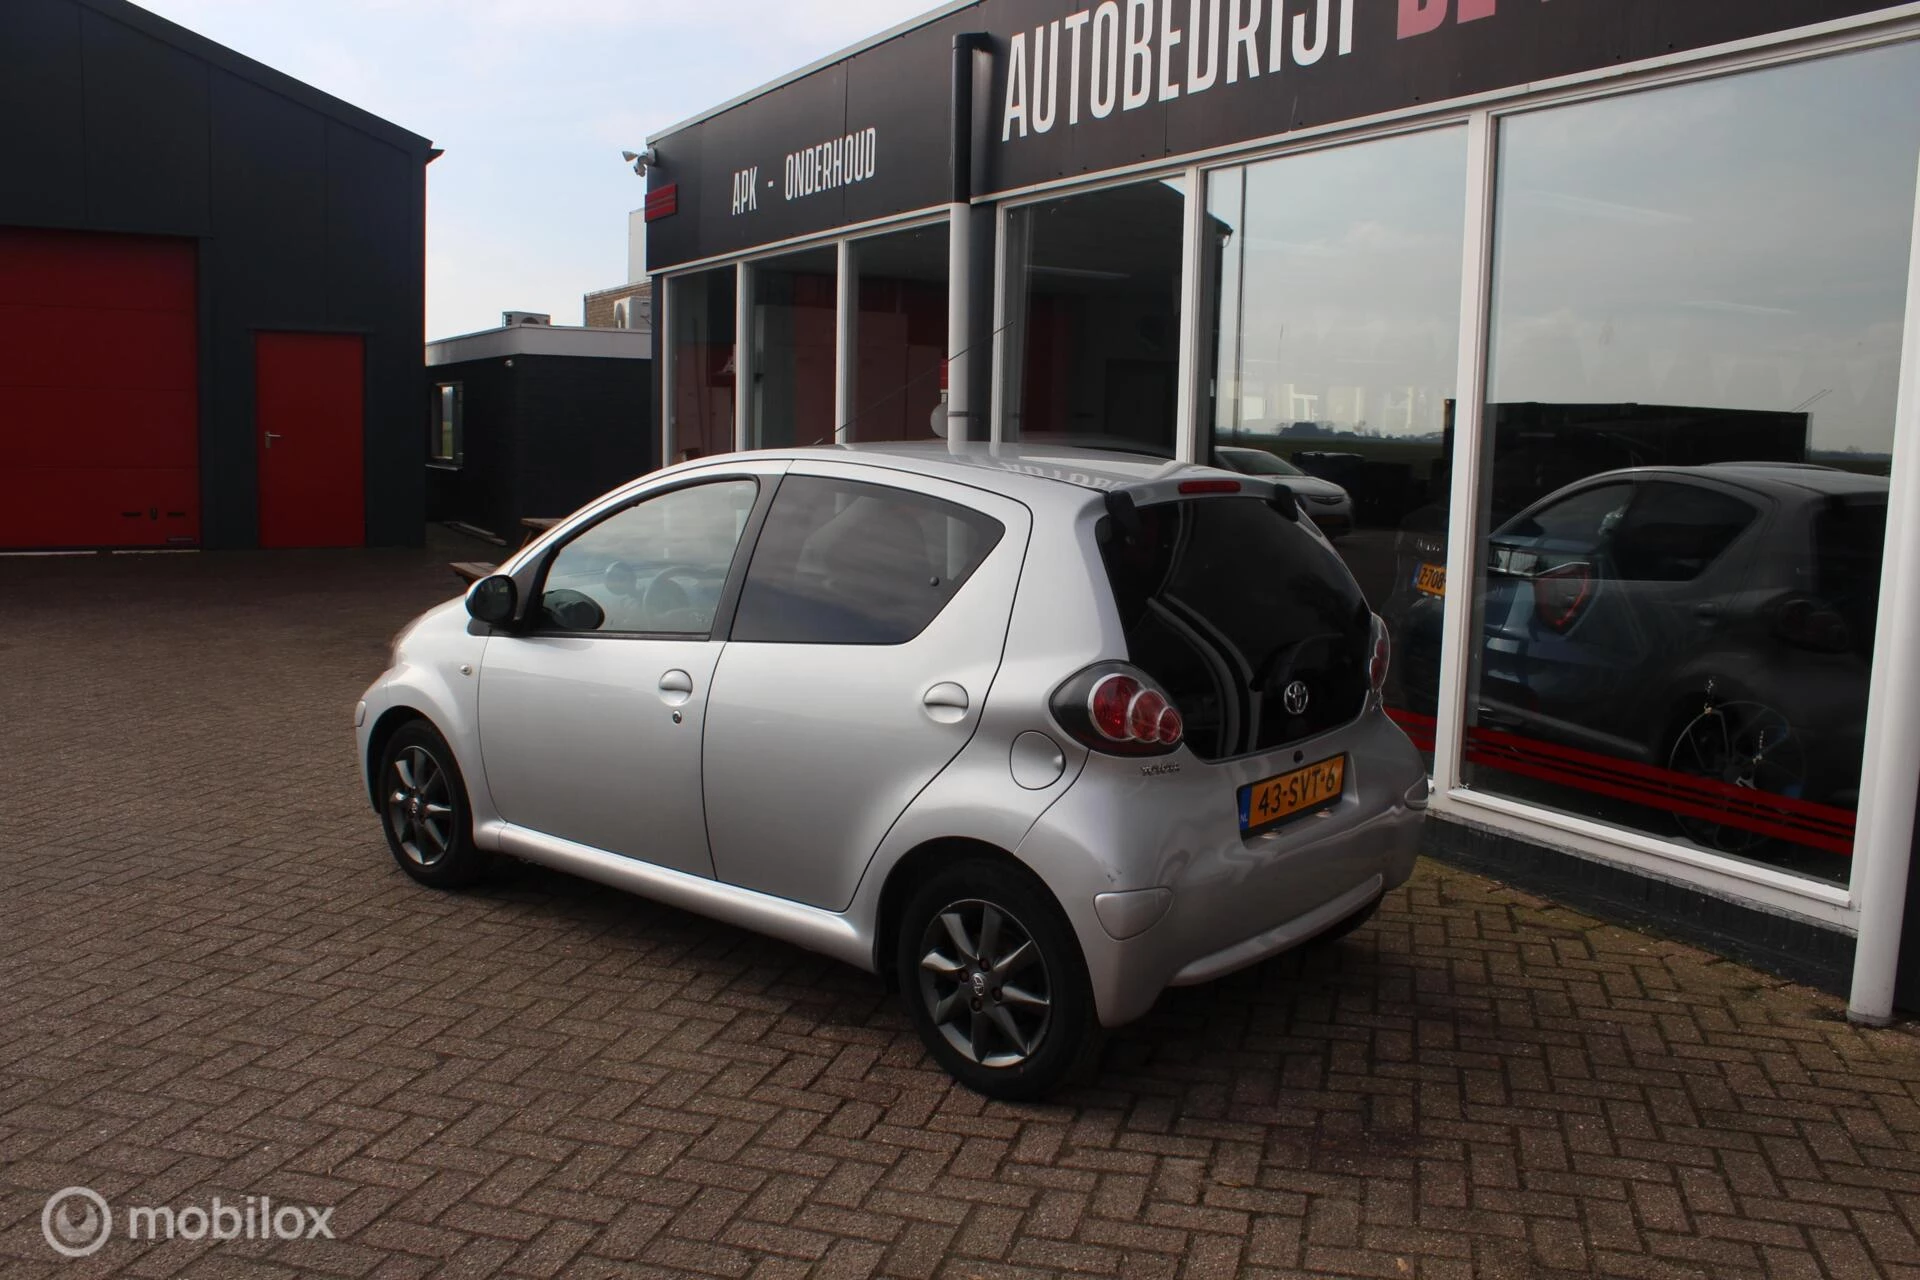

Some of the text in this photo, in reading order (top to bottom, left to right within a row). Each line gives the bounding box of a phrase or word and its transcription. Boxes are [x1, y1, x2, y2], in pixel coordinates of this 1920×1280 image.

[732, 166, 758, 216] APK
[785, 127, 876, 201] ONDERHOUD
[1257, 762, 1336, 817] 43-SVT-6
